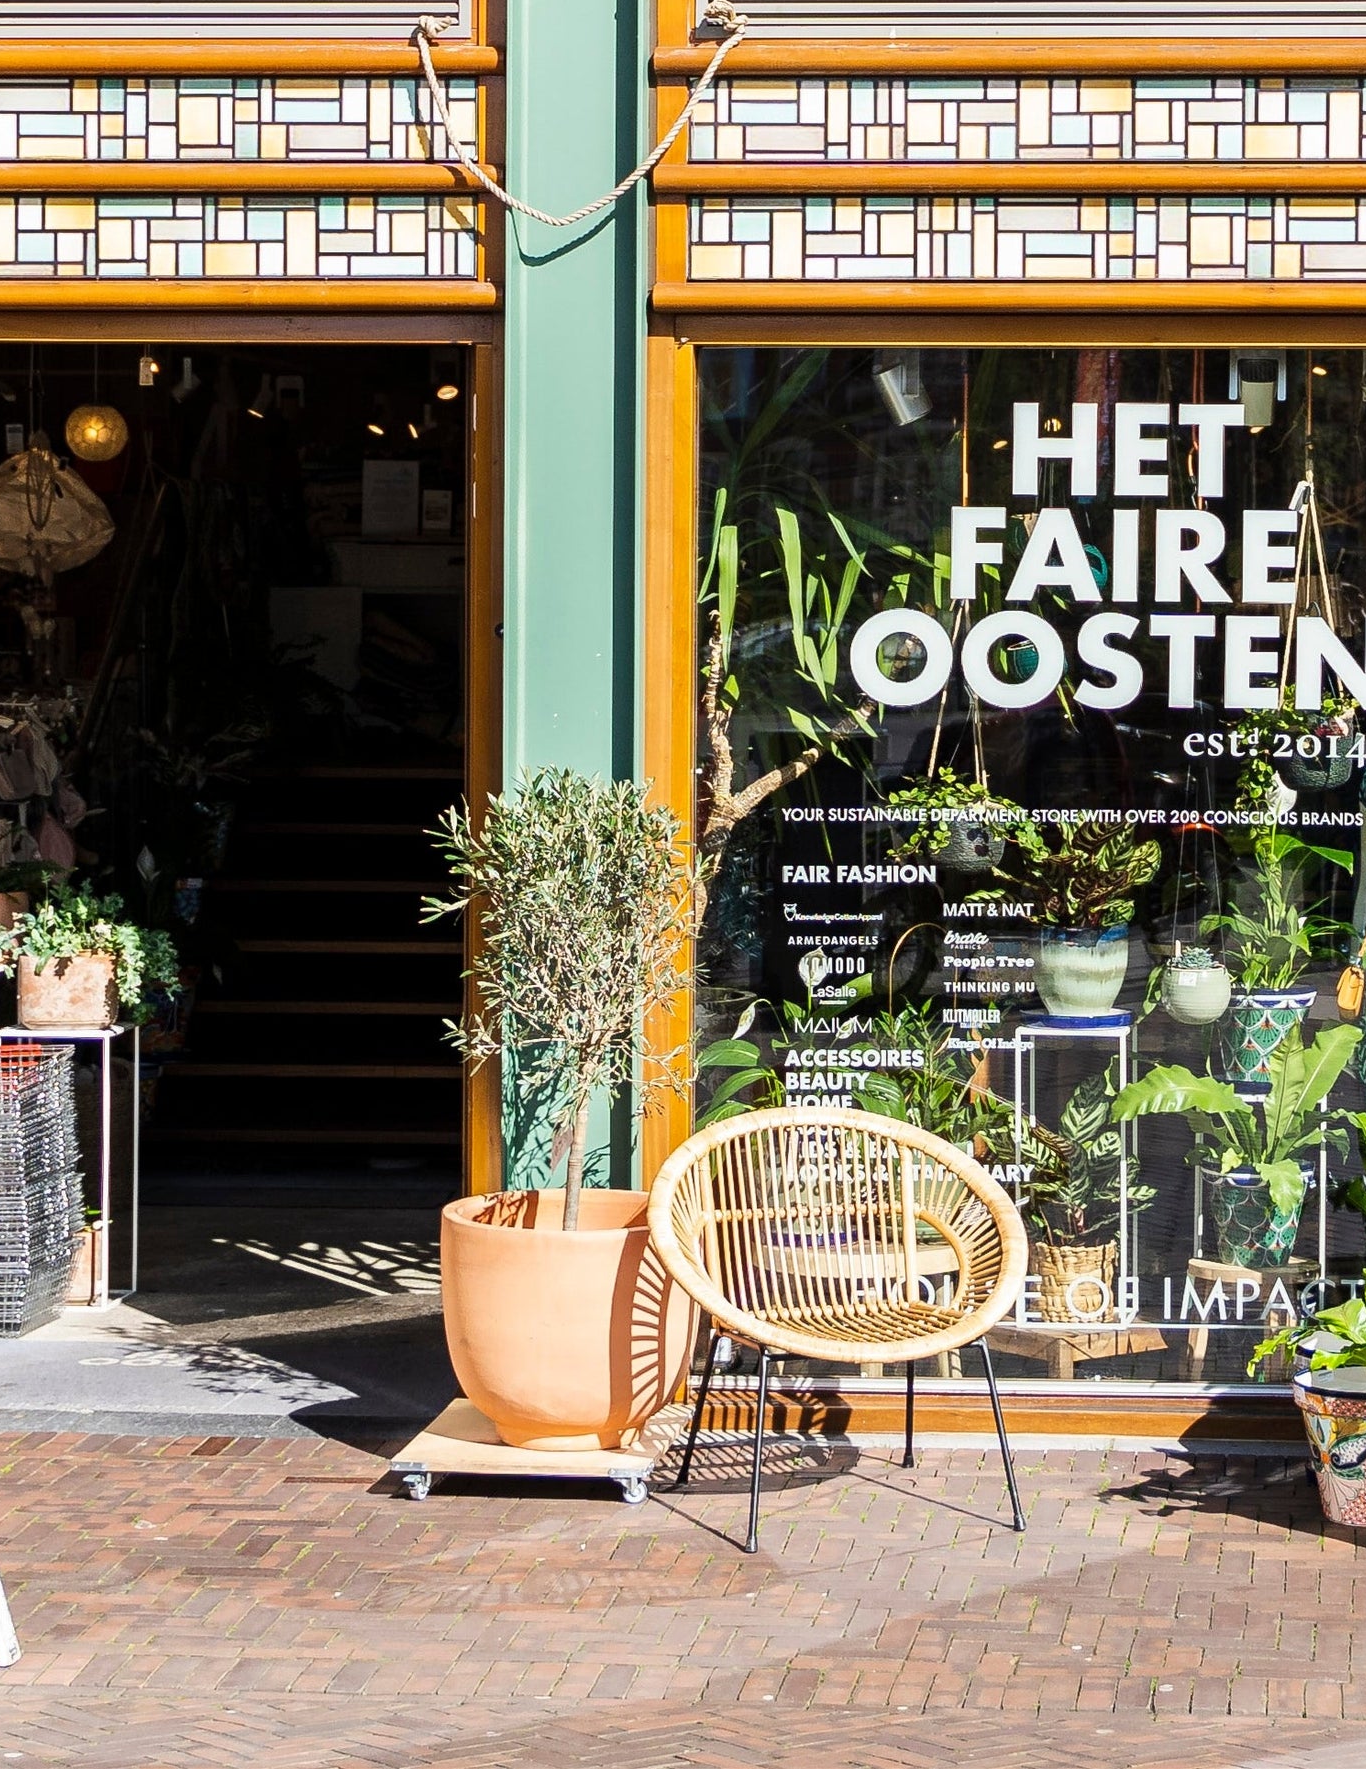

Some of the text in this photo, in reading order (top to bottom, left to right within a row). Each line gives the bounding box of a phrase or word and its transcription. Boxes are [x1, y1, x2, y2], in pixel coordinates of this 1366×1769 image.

[1012, 402, 1246, 498] HET
[950, 506, 1300, 604] FAIRE
[782, 808, 1364, 826] YOUR SUSTAINABLE DEPARTMENT STORE WITH OVER 200 CONSCIOUS BRANDS
[783, 865, 937, 883] FAIR FASHION
[943, 903, 1035, 917] MATT & NAT
[787, 935, 879, 946] ARMEDANGELS
[943, 956, 1035, 970] People Tree
[943, 981, 1034, 993] THINKING MU
[784, 1049, 924, 1067] ACCESSOIRES
[785, 1072, 870, 1090] BEAUTY
[785, 1094, 853, 1108] HOME
[1164, 1275, 1366, 1321] IMPACT
